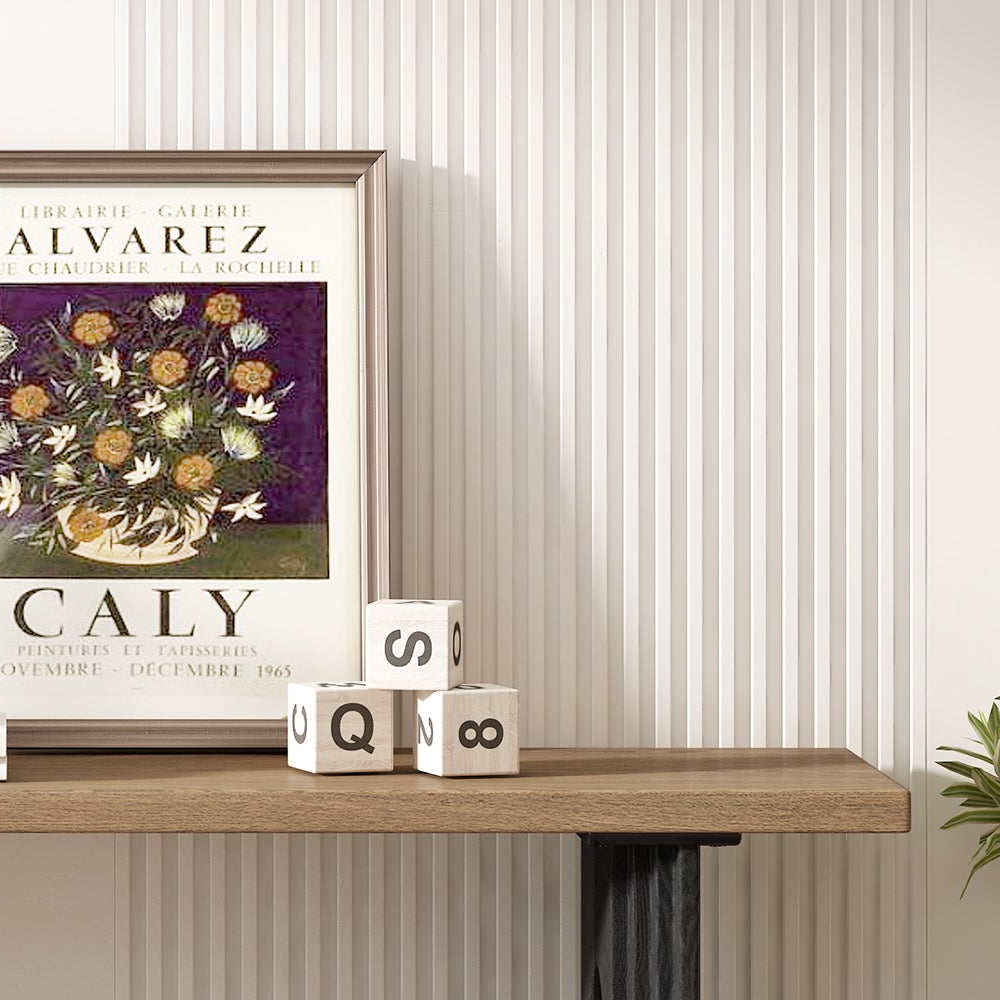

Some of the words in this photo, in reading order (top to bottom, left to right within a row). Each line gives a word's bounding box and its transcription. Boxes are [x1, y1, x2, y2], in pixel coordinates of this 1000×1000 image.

[21, 204, 130, 219] LIBRAIRIE
[158, 204, 251, 218] GALERIE
[7, 226, 267, 255] ALVAREZ
[28, 262, 149, 275] CHAUDRIER
[180, 261, 202, 274] LA
[215, 260, 319, 274] ROCHELLE
[13, 587, 260, 638] CALY
[18, 644, 110, 657] PEINTURES
[124, 645, 141, 657] ET
[159, 645, 257, 657] TAPISSERIES
[385, 629, 432, 667] S
[130, 660, 243, 678] DÉCEMBRE
[258, 665, 291, 677] 1965
[331, 703, 375, 754] Q
[459, 718, 503, 749] 8
